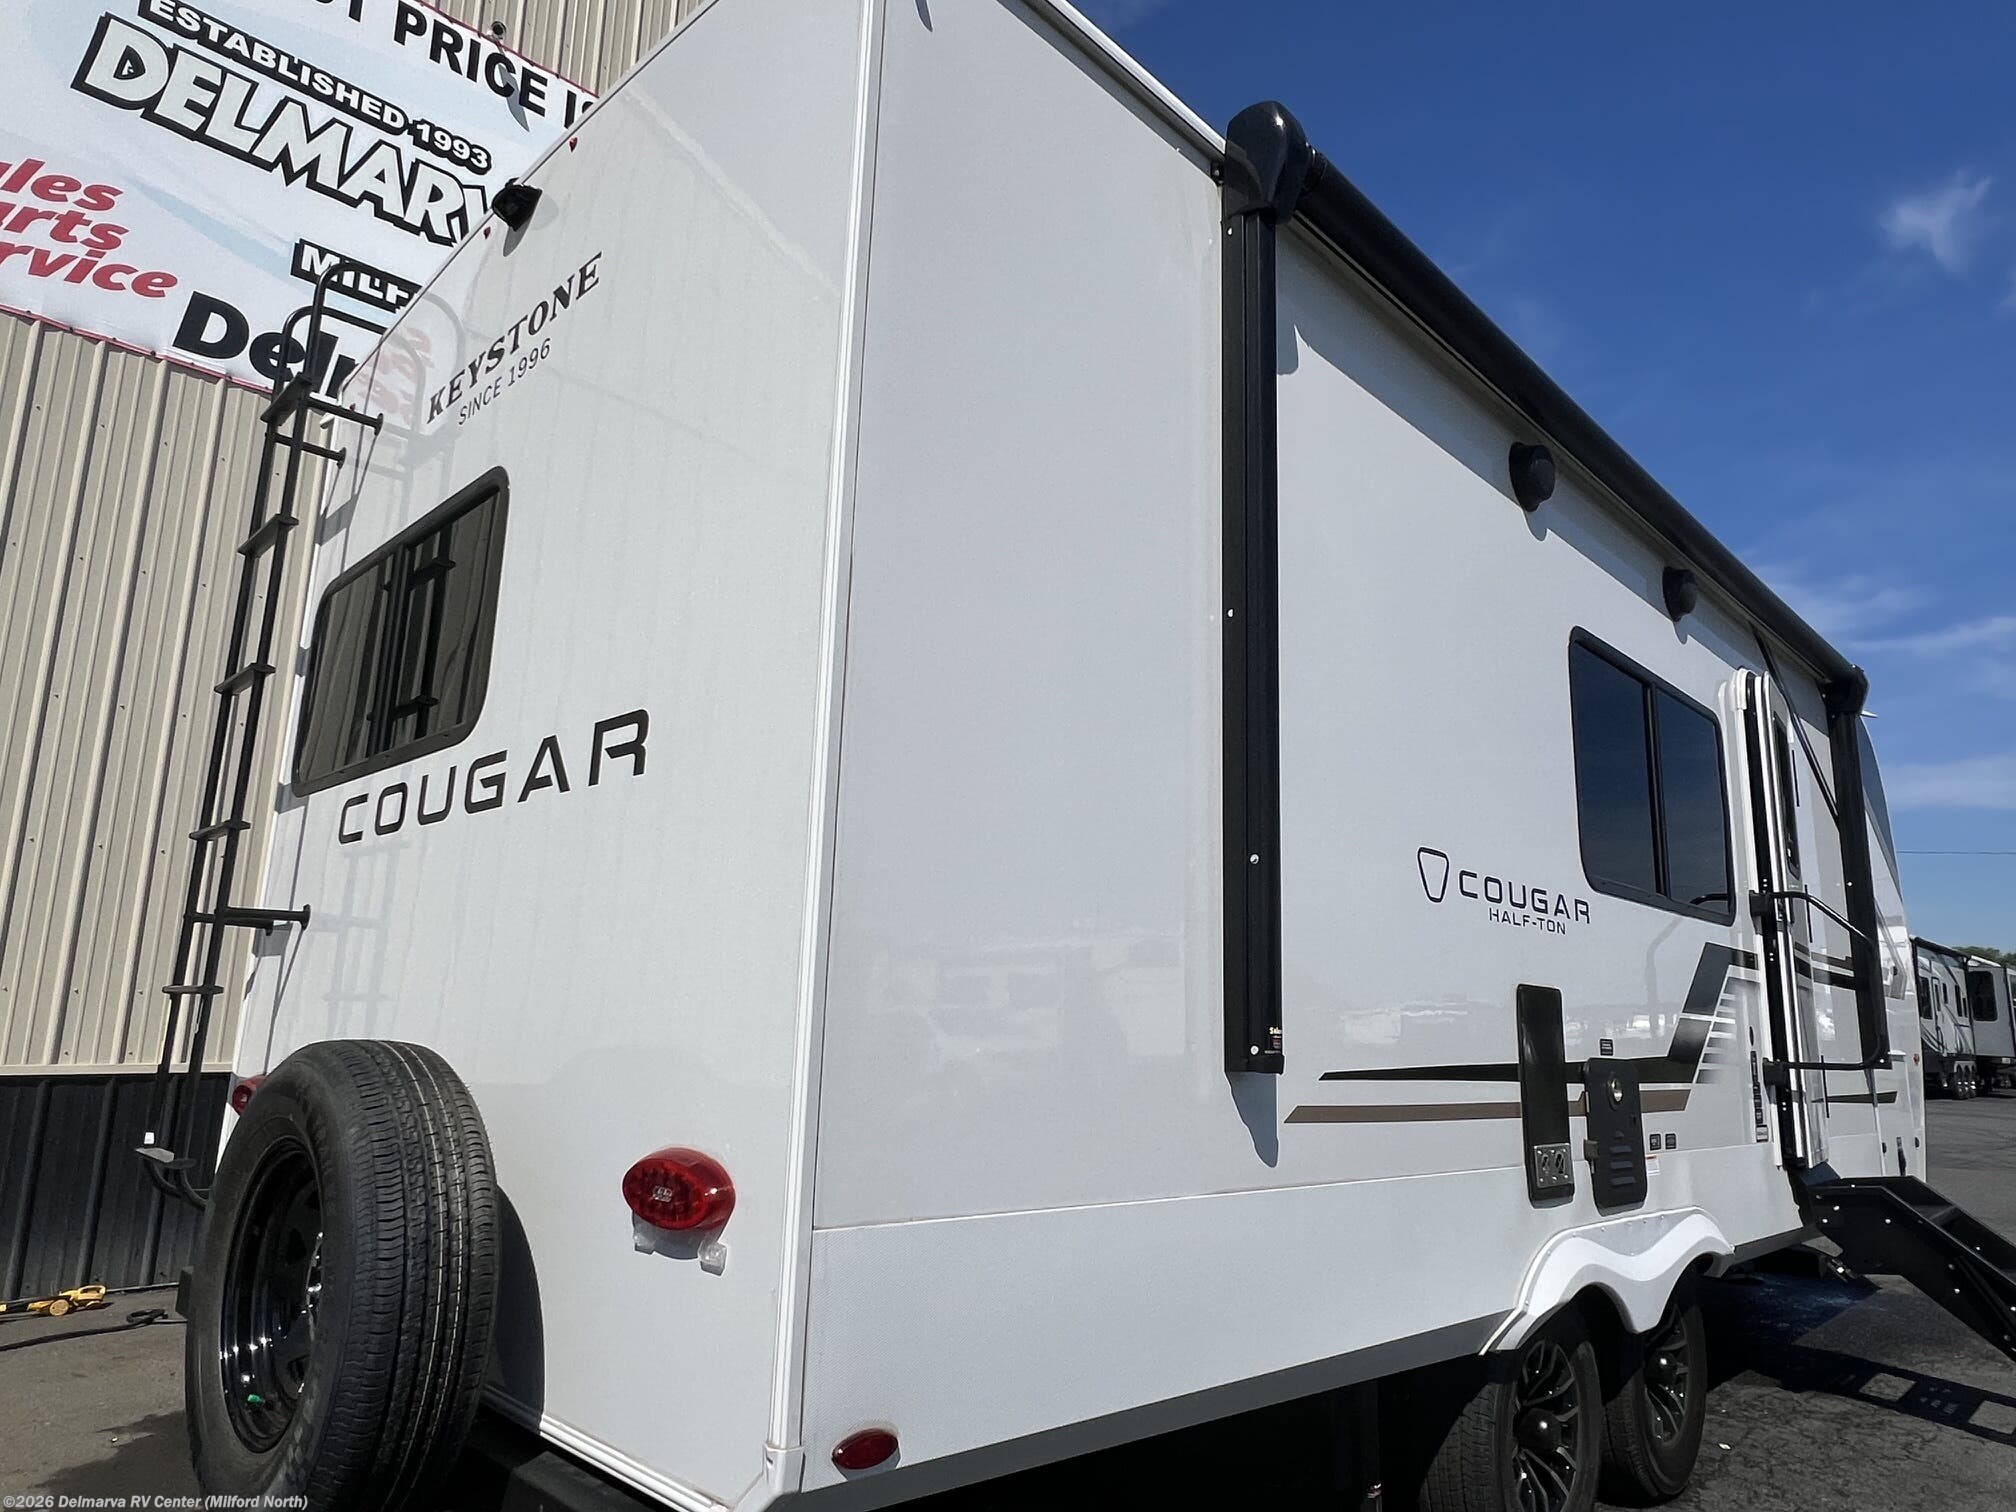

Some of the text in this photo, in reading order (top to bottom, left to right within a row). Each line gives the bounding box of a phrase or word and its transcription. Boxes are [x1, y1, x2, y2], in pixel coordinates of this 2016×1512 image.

[149, 0, 488, 169] ESTABLISHED 1993
[393, 2, 595, 129] PRICE I
[0, 158, 124, 211] les
[0, 202, 130, 250] rts
[172, 291, 358, 400] Del
[427, 251, 602, 424] KEYSTONE
[458, 338, 551, 425] SINCE 1996
[338, 709, 649, 844] COUGAR
[1459, 870, 1590, 924] COUGAR
[1489, 907, 1566, 935] HALF-TON
